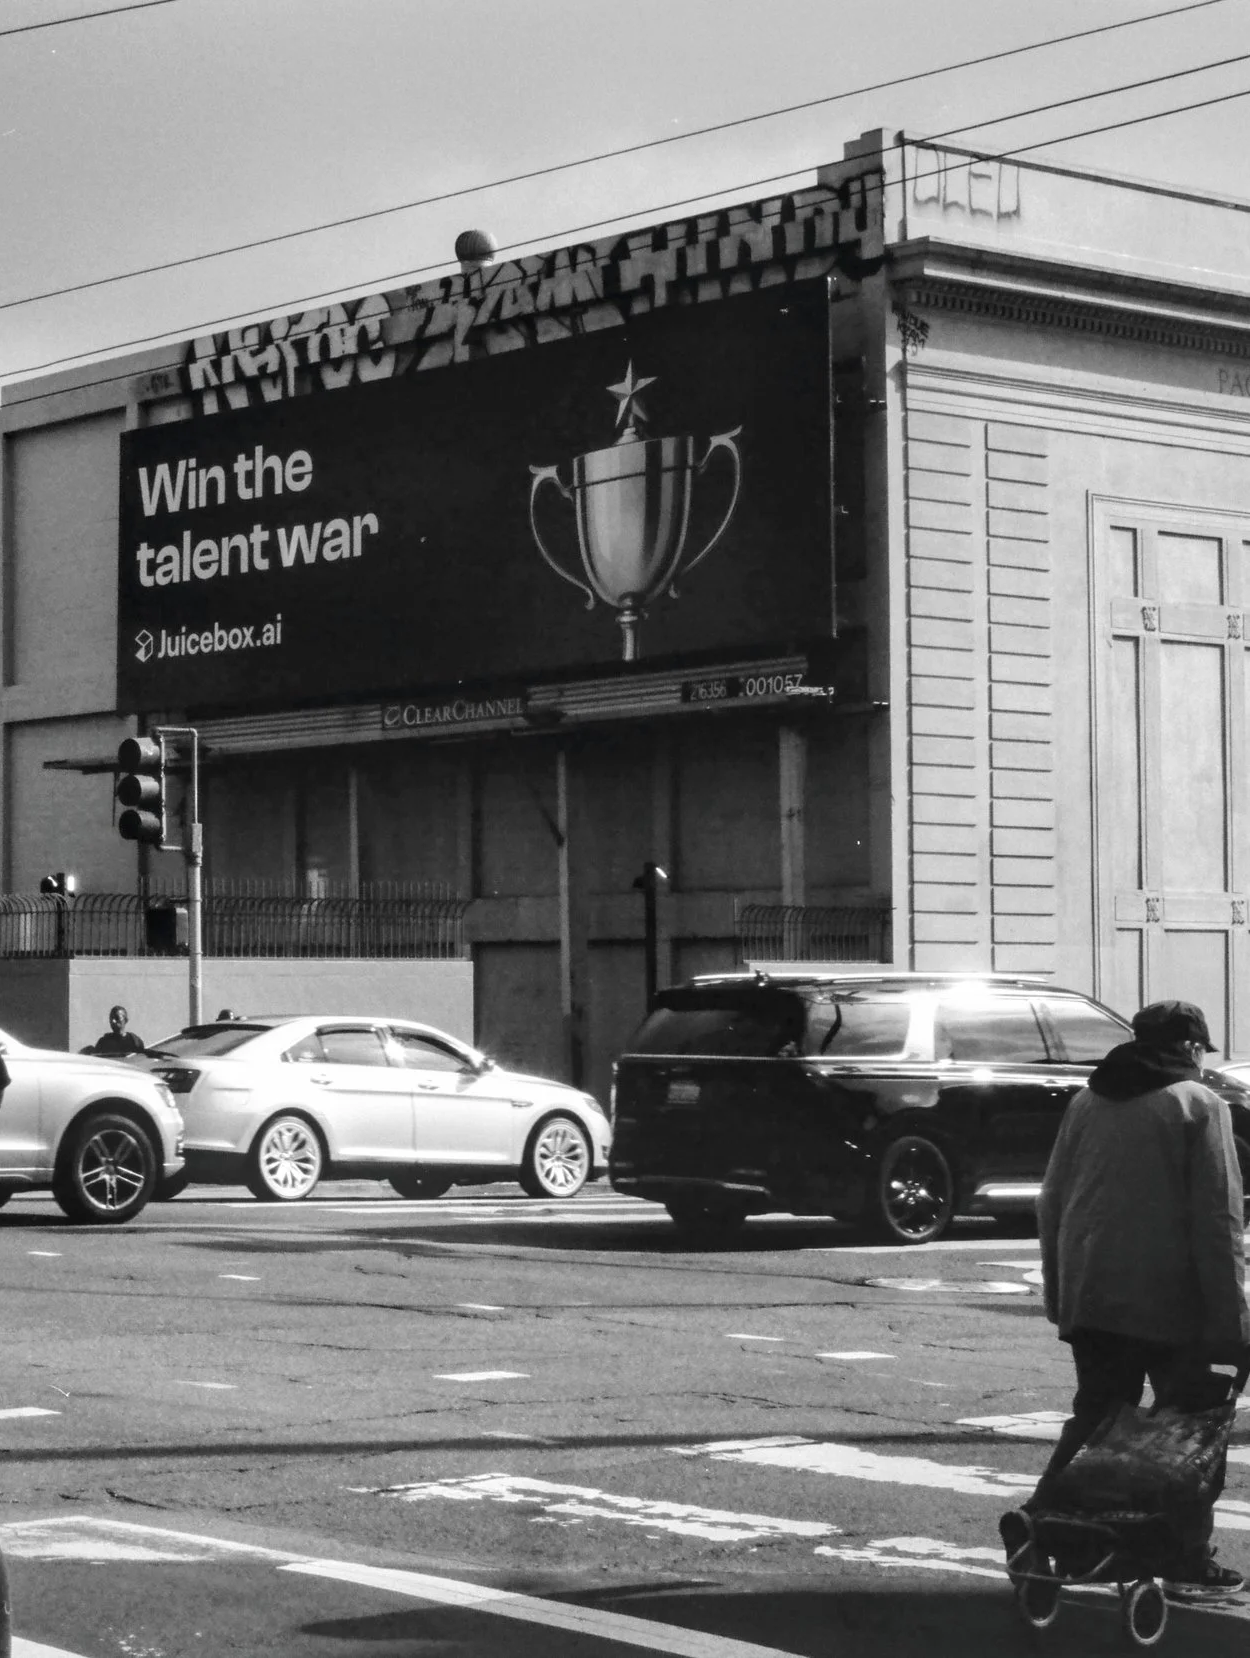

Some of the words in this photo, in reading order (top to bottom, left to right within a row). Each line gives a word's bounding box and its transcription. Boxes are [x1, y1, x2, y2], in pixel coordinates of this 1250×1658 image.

[138, 458, 226, 518] Win
[234, 445, 313, 501] the
[137, 524, 270, 588] talent
[277, 513, 380, 568] war
[158, 613, 282, 659] Juicebox.ai
